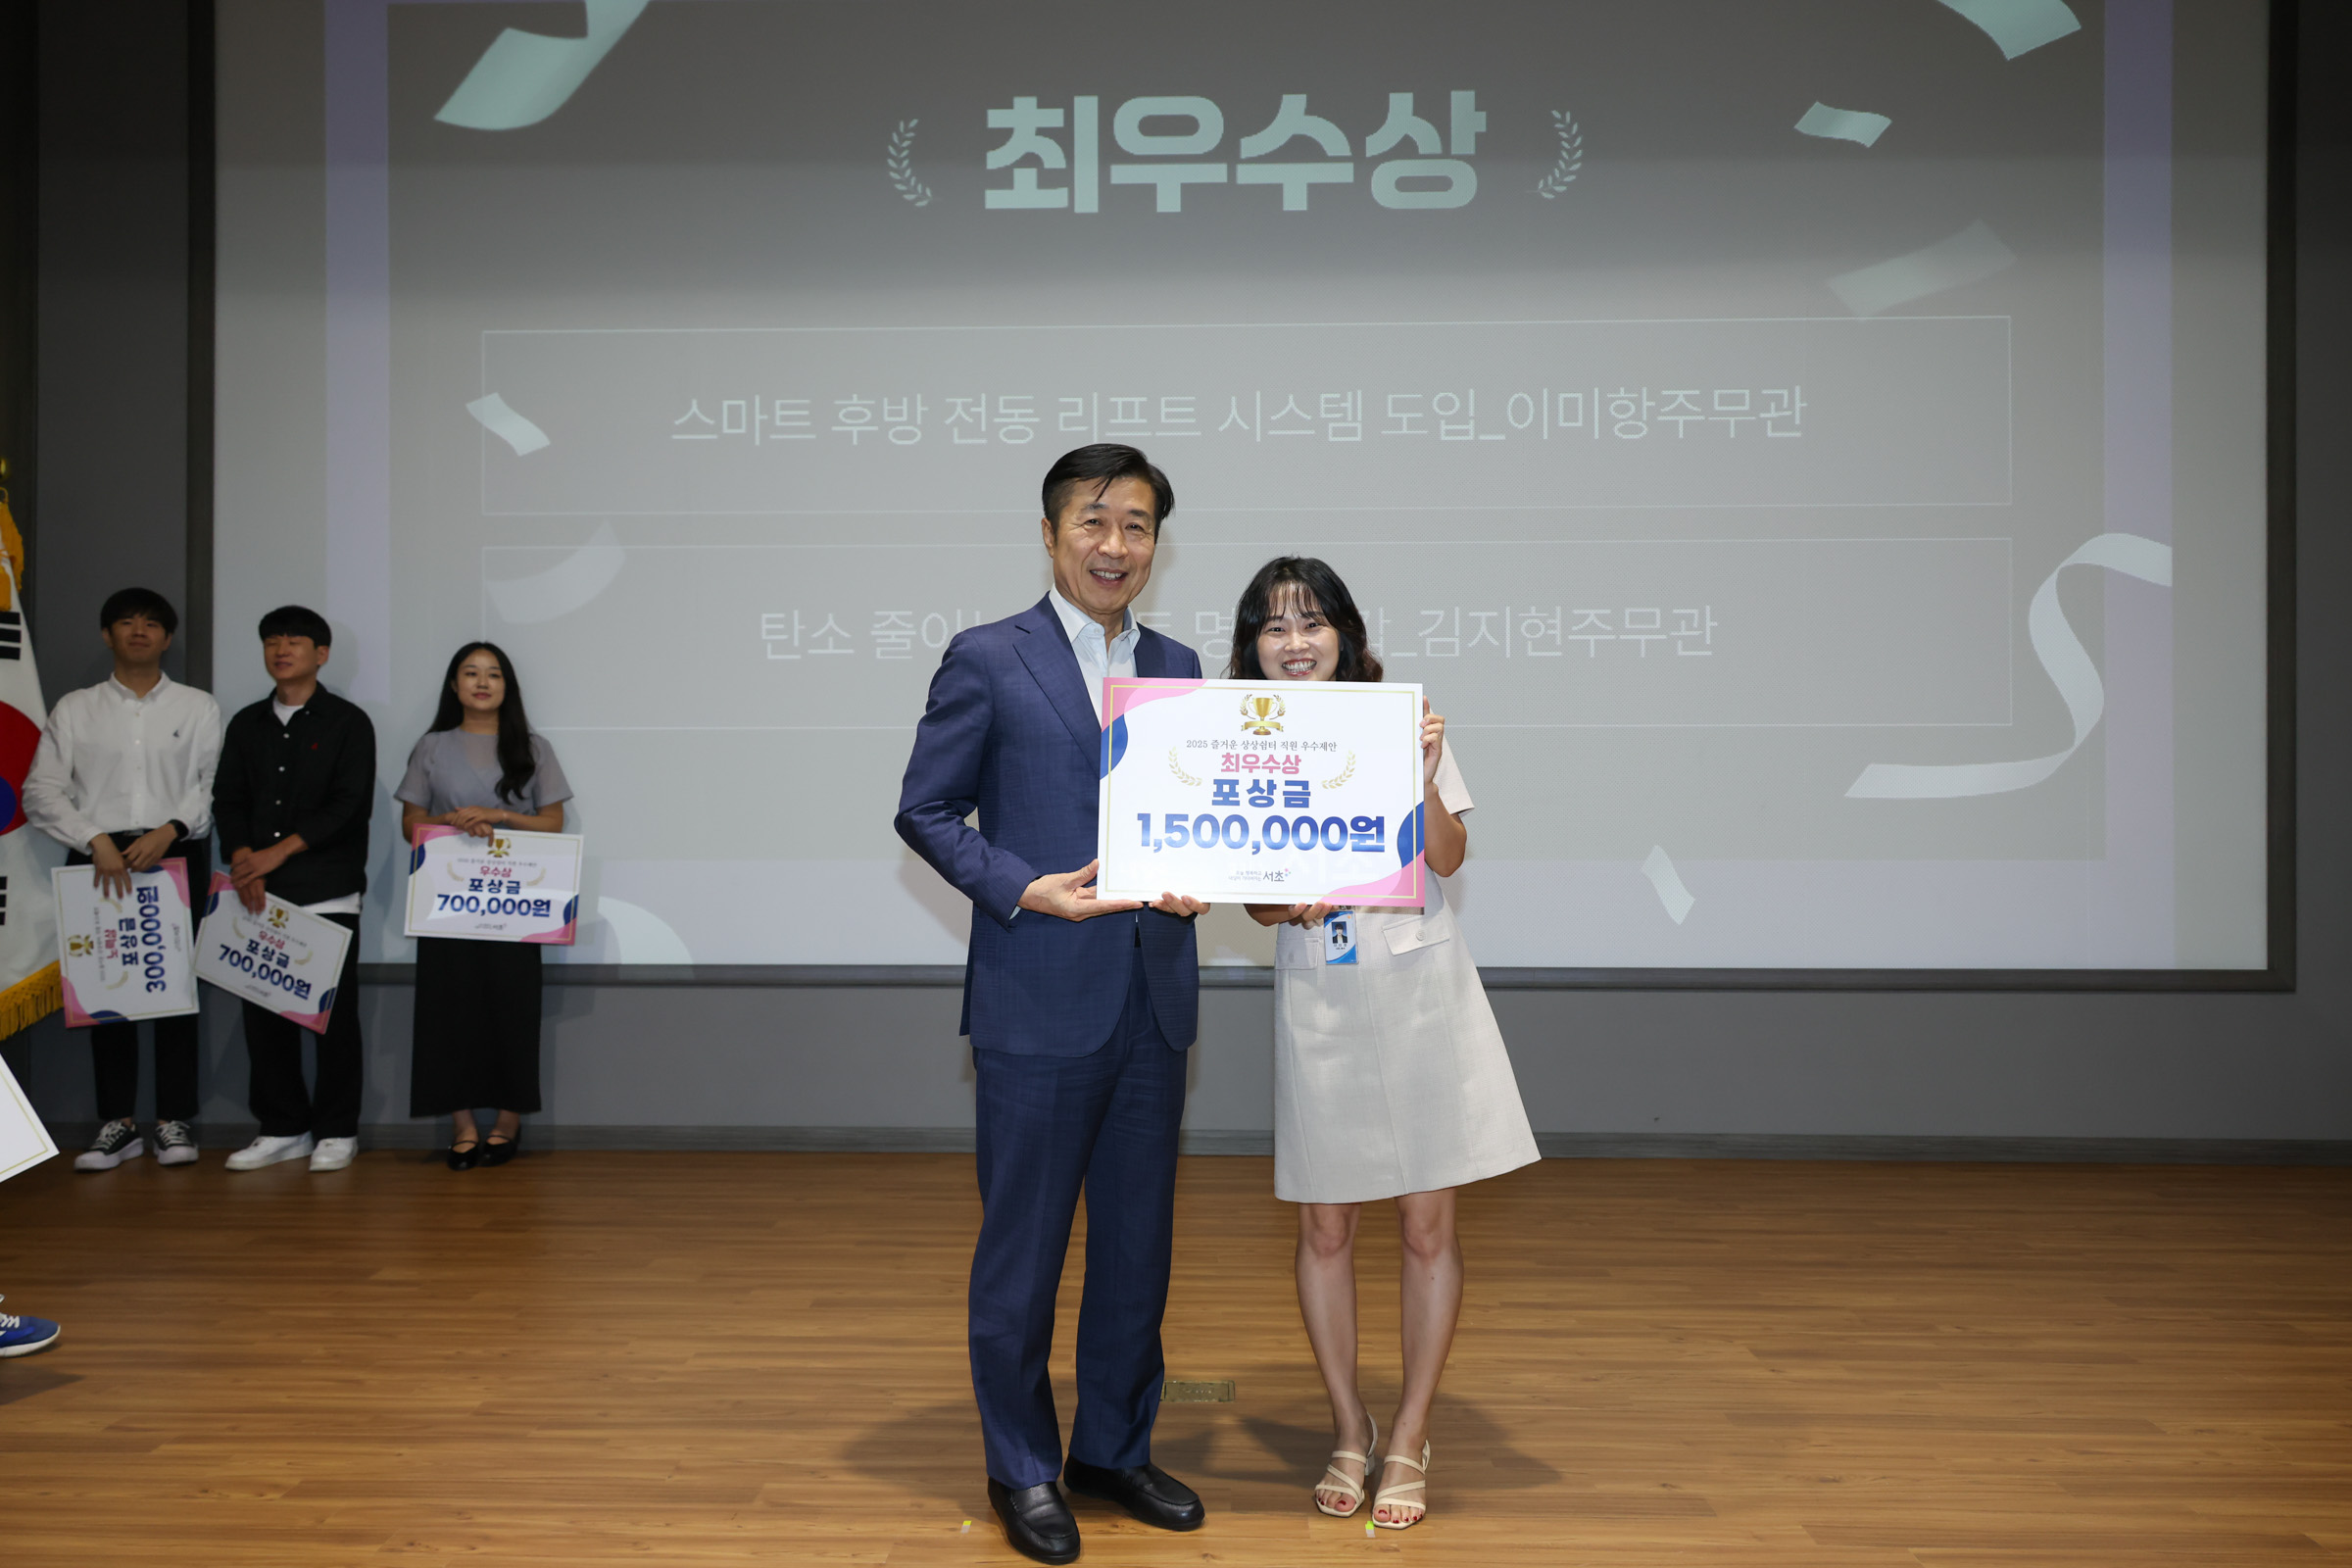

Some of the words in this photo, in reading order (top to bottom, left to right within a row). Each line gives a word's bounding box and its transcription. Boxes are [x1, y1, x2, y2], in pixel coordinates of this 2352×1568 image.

[985, 90, 1487, 214] 최우수상
[671, 394, 816, 446] 스마트
[831, 394, 928, 446] 후방
[944, 394, 1041, 446] 전동
[1057, 391, 1202, 444] 리프트
[1218, 390, 1363, 442] 시스템
[1381, 386, 1807, 440] 도입_이미항주무관
[760, 609, 855, 661] 탄소
[870, 609, 981, 661] 줄이
[1186, 740, 1208, 749] 2025
[1210, 739, 1238, 751] 즐거운
[1241, 740, 1277, 751] 상상쉼터
[1280, 741, 1298, 752] 직원
[1300, 741, 1338, 752] 우수제안
[1221, 753, 1301, 774] 최우수상
[1212, 779, 1311, 808] 포상금
[1137, 813, 1386, 855] 1,500,000원
[468, 878, 521, 895] 포상금
[480, 866, 513, 878] 우수상
[1263, 870, 1285, 882] 서초
[437, 894, 552, 917] 700,000원
[119, 917, 139, 966] 포상금
[136, 886, 167, 993] 300,000원
[246, 939, 290, 969] 포상금
[219, 944, 312, 1001] 700,000원
